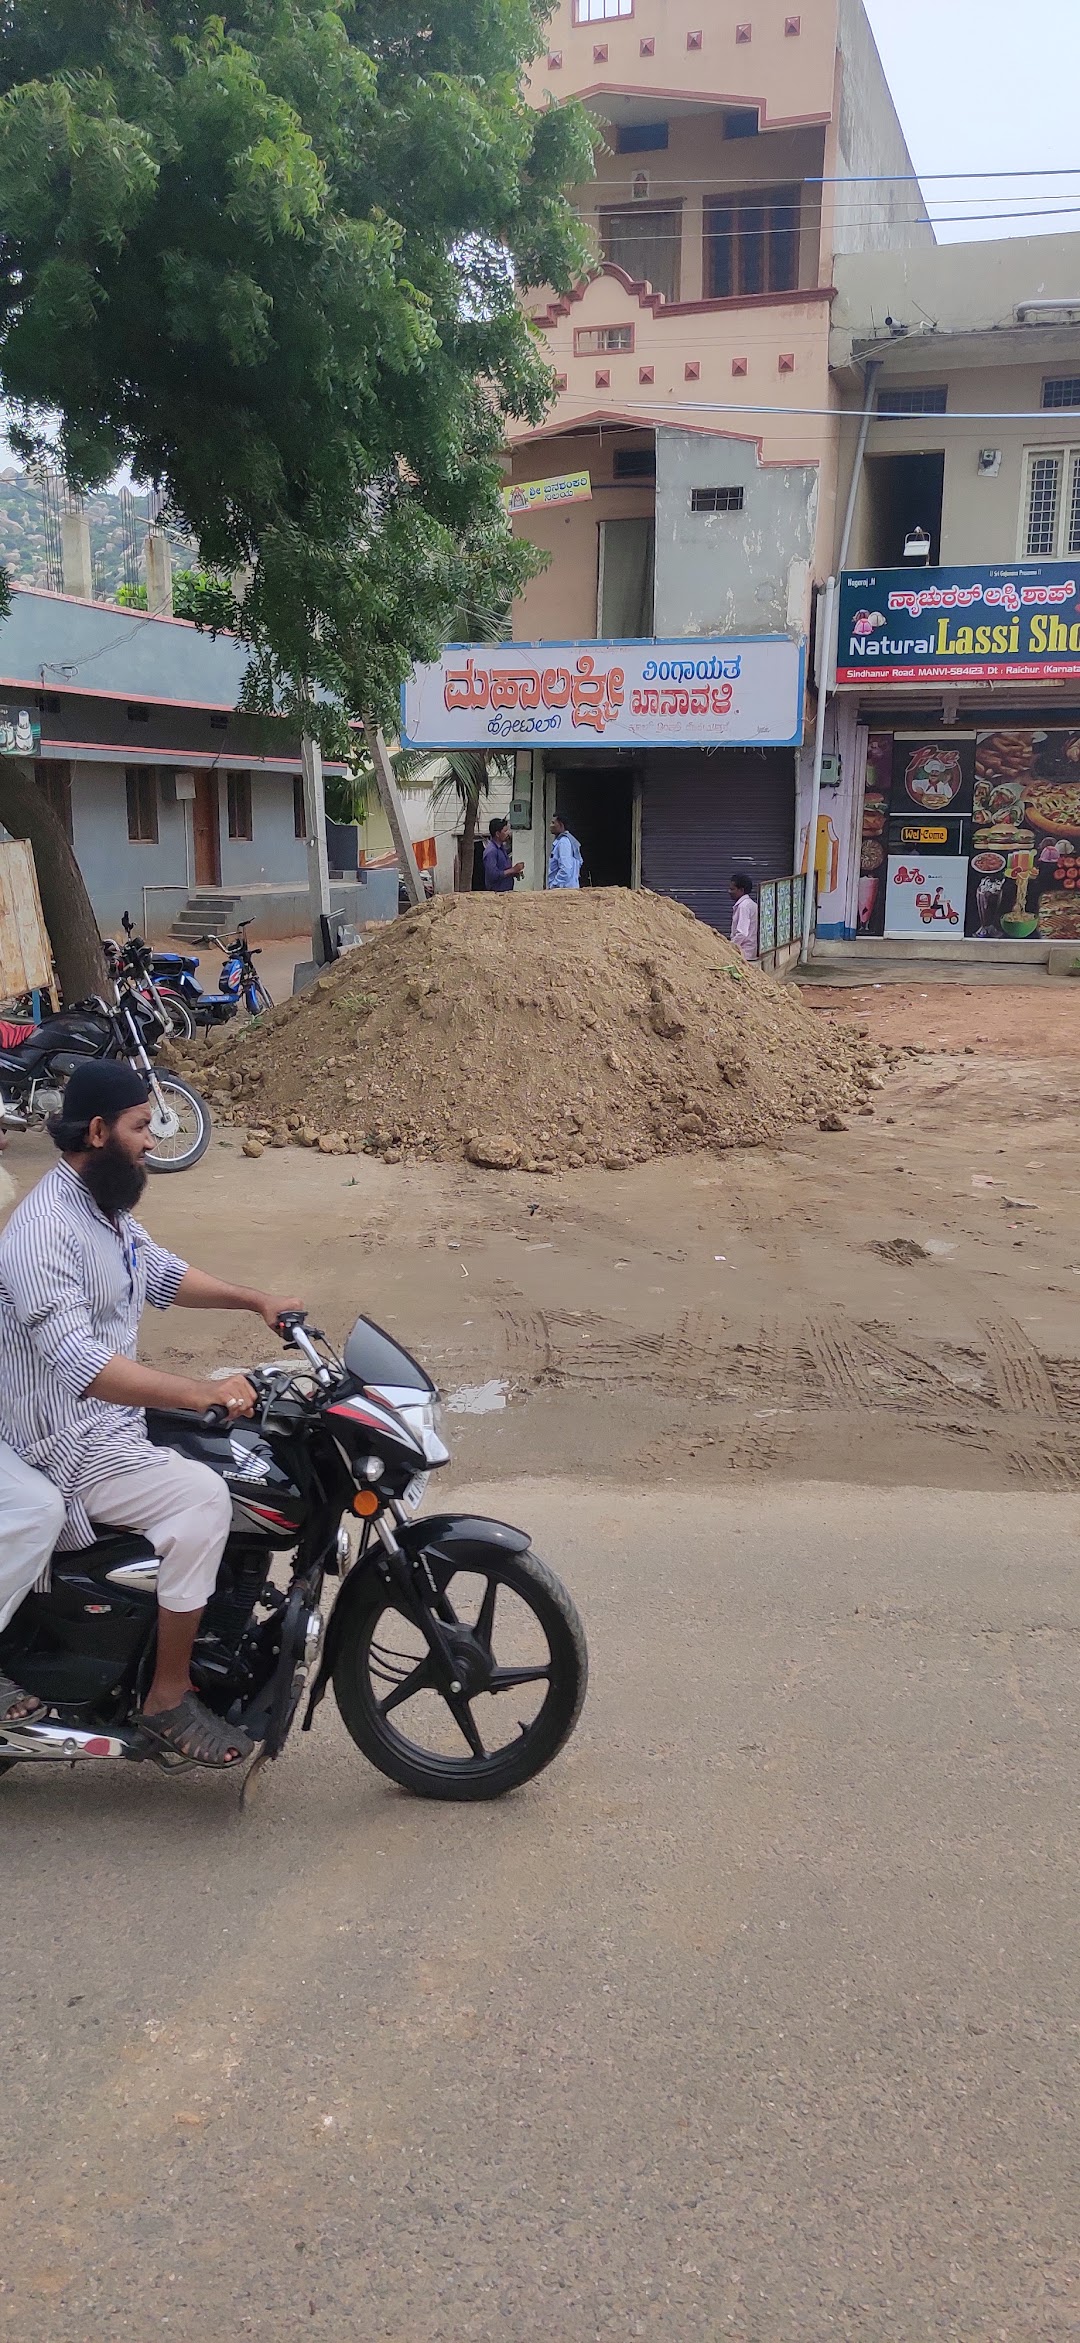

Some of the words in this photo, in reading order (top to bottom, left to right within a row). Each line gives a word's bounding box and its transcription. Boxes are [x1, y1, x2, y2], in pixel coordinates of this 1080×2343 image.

[888, 584, 982, 617] ನ್ಯಾಚುರಲ್
[984, 583, 1021, 611] ಲಸ್ಸಿ
[1021, 580, 1076, 604] ಶಾಪ್
[849, 634, 935, 656] Natural
[936, 616, 1020, 655] Lassi
[642, 655, 742, 683] ಲಿಂಗಾಯತ
[846, 669, 890, 678] Sindhanur
[891, 668, 916, 677] Road.
